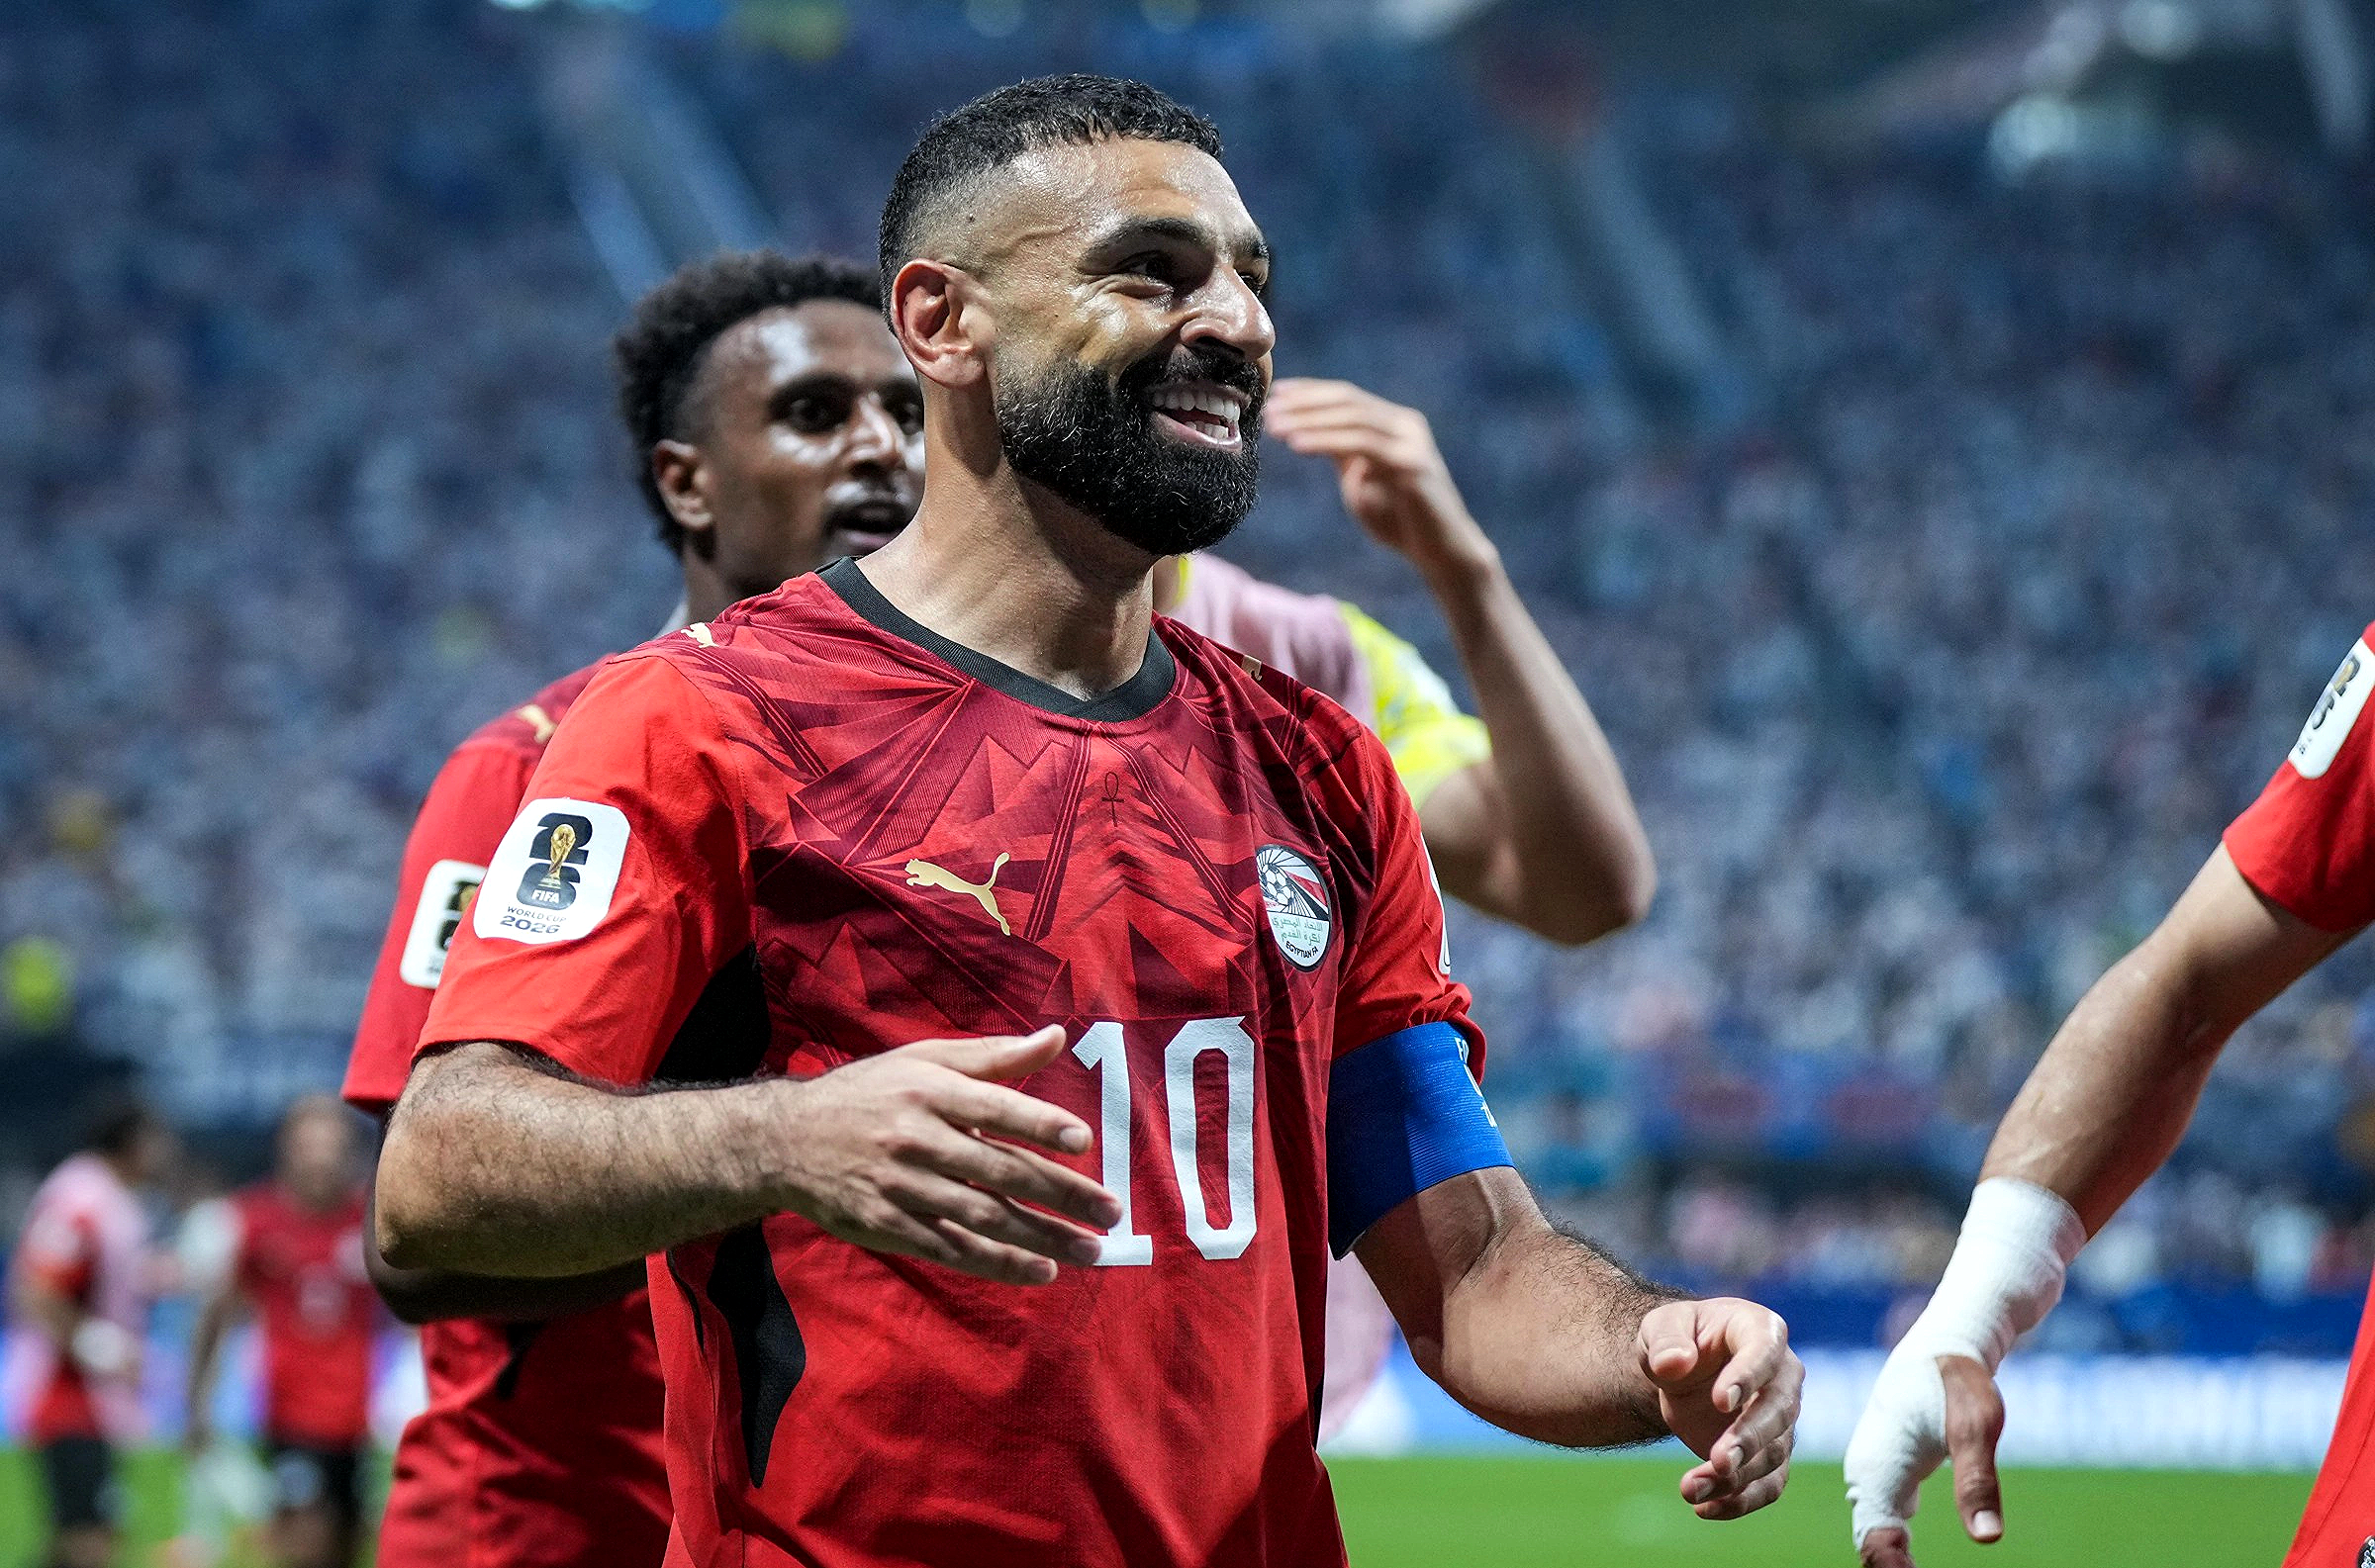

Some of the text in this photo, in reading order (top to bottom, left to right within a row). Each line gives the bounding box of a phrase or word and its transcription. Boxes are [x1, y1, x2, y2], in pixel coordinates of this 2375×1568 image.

[531, 888, 560, 904] FIFA
[507, 905, 567, 923] WORLD CUP
[499, 915, 561, 934] 2026
[1285, 940, 1312, 958] EGYPTIAN
[1072, 1016, 1258, 1266] 10
